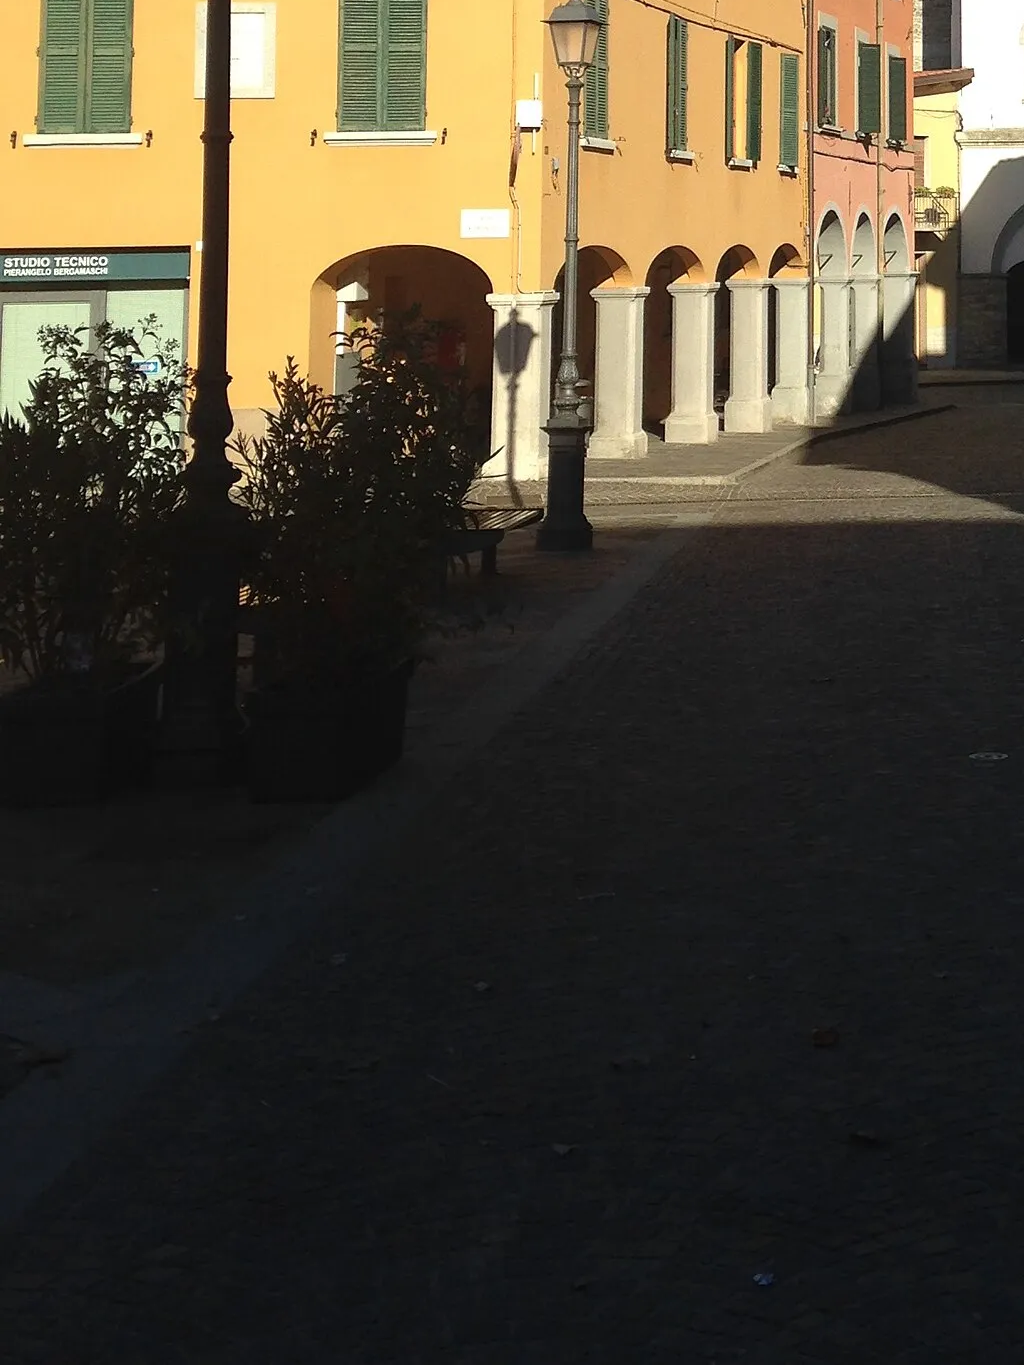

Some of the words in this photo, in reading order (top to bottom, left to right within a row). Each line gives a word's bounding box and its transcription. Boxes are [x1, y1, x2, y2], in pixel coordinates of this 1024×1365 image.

[3, 257, 51, 268] STUDIO
[53, 256, 108, 267] TECNICO
[3, 268, 52, 276] PIERANGELO
[53, 267, 108, 276] BERGAMASCHI
